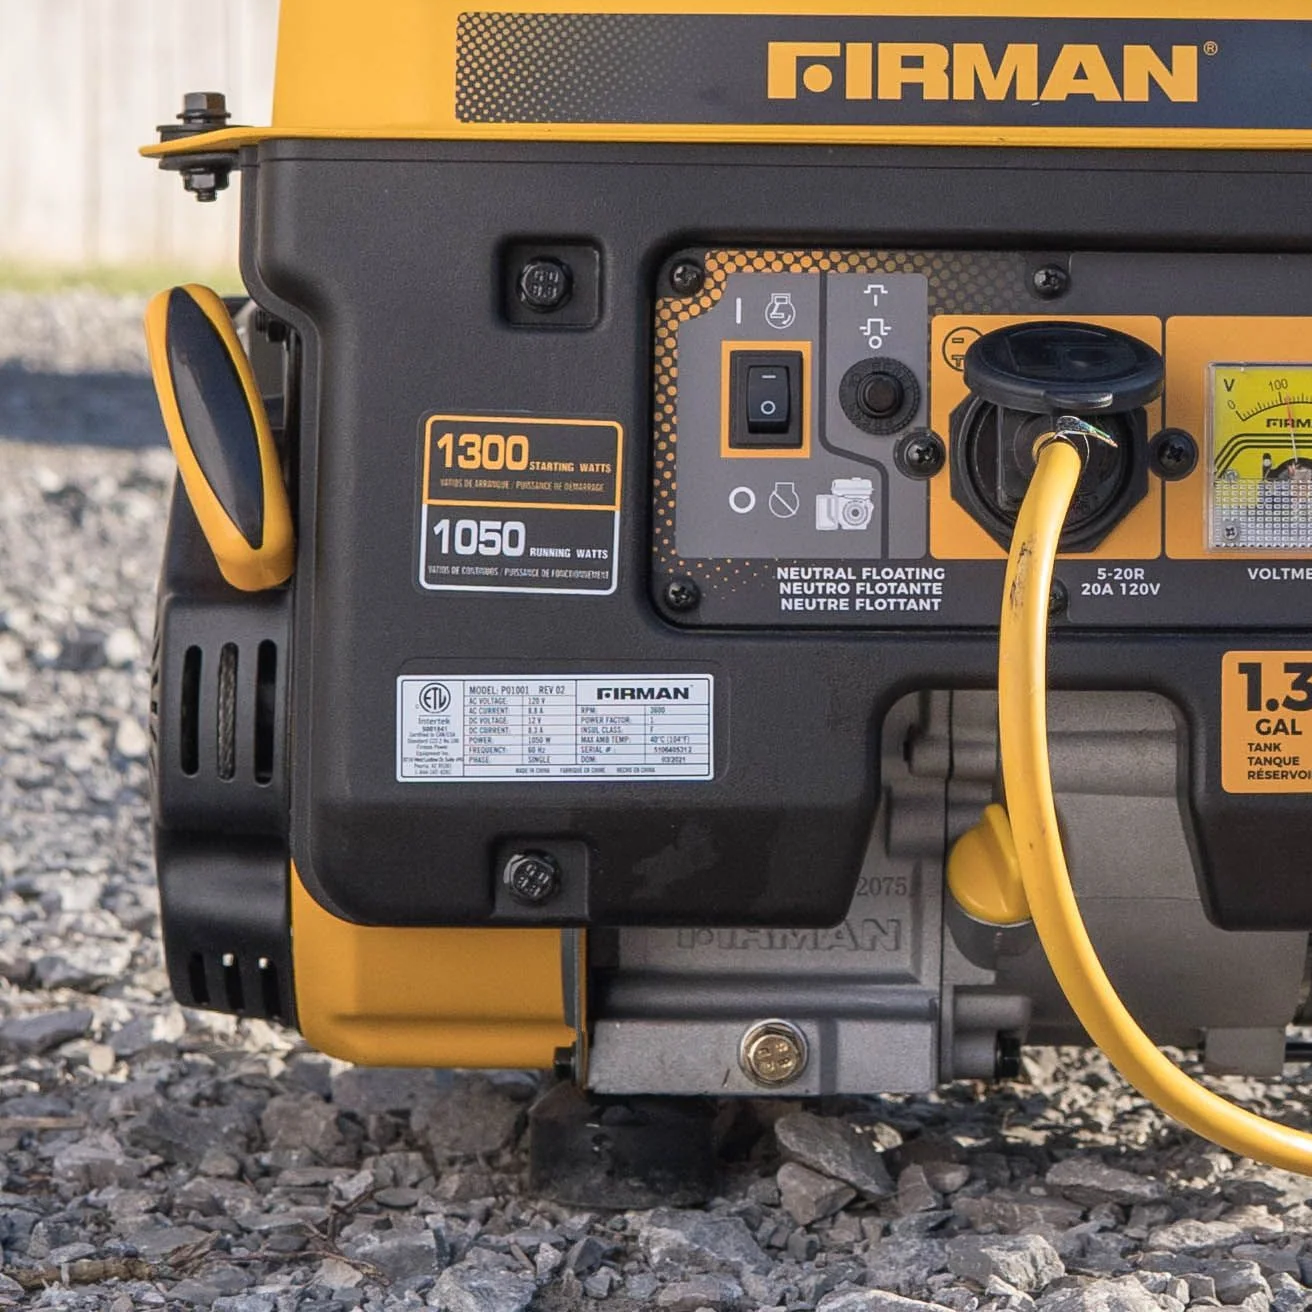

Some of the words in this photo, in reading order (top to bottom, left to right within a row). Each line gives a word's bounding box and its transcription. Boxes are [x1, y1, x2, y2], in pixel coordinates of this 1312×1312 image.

[767, 41, 1198, 102] FIRMAN
[1223, 379, 1235, 392] V
[1227, 399, 1236, 410] 0
[1268, 378, 1288, 392] 100
[437, 432, 530, 471] 1300
[529, 461, 575, 472] STARTING
[580, 463, 612, 474] WATTS
[433, 518, 526, 557] 1050
[530, 547, 571, 559] RUNNING
[576, 548, 609, 560] WATTS
[776, 567, 857, 580] NEUTRAL
[861, 567, 945, 580] FLOATING
[1097, 568, 1145, 581] 5-20R
[779, 582, 850, 595] NEUTRO
[855, 582, 943, 595] FLOTANTE
[1080, 583, 1114, 596] 20A
[1119, 583, 1161, 596] 120V
[780, 598, 849, 611] NEUTRE
[855, 598, 942, 611] FLOTTANT
[469, 686, 499, 695] MODEL:
[501, 686, 529, 695] P01001
[538, 686, 554, 695] REV
[555, 686, 565, 695] 02
[596, 687, 689, 700] FIRMAN
[1255, 718, 1303, 736] GAL
[1247, 742, 1281, 752] TANK
[1247, 756, 1300, 767] TANQUE
[857, 876, 907, 896] 2075
